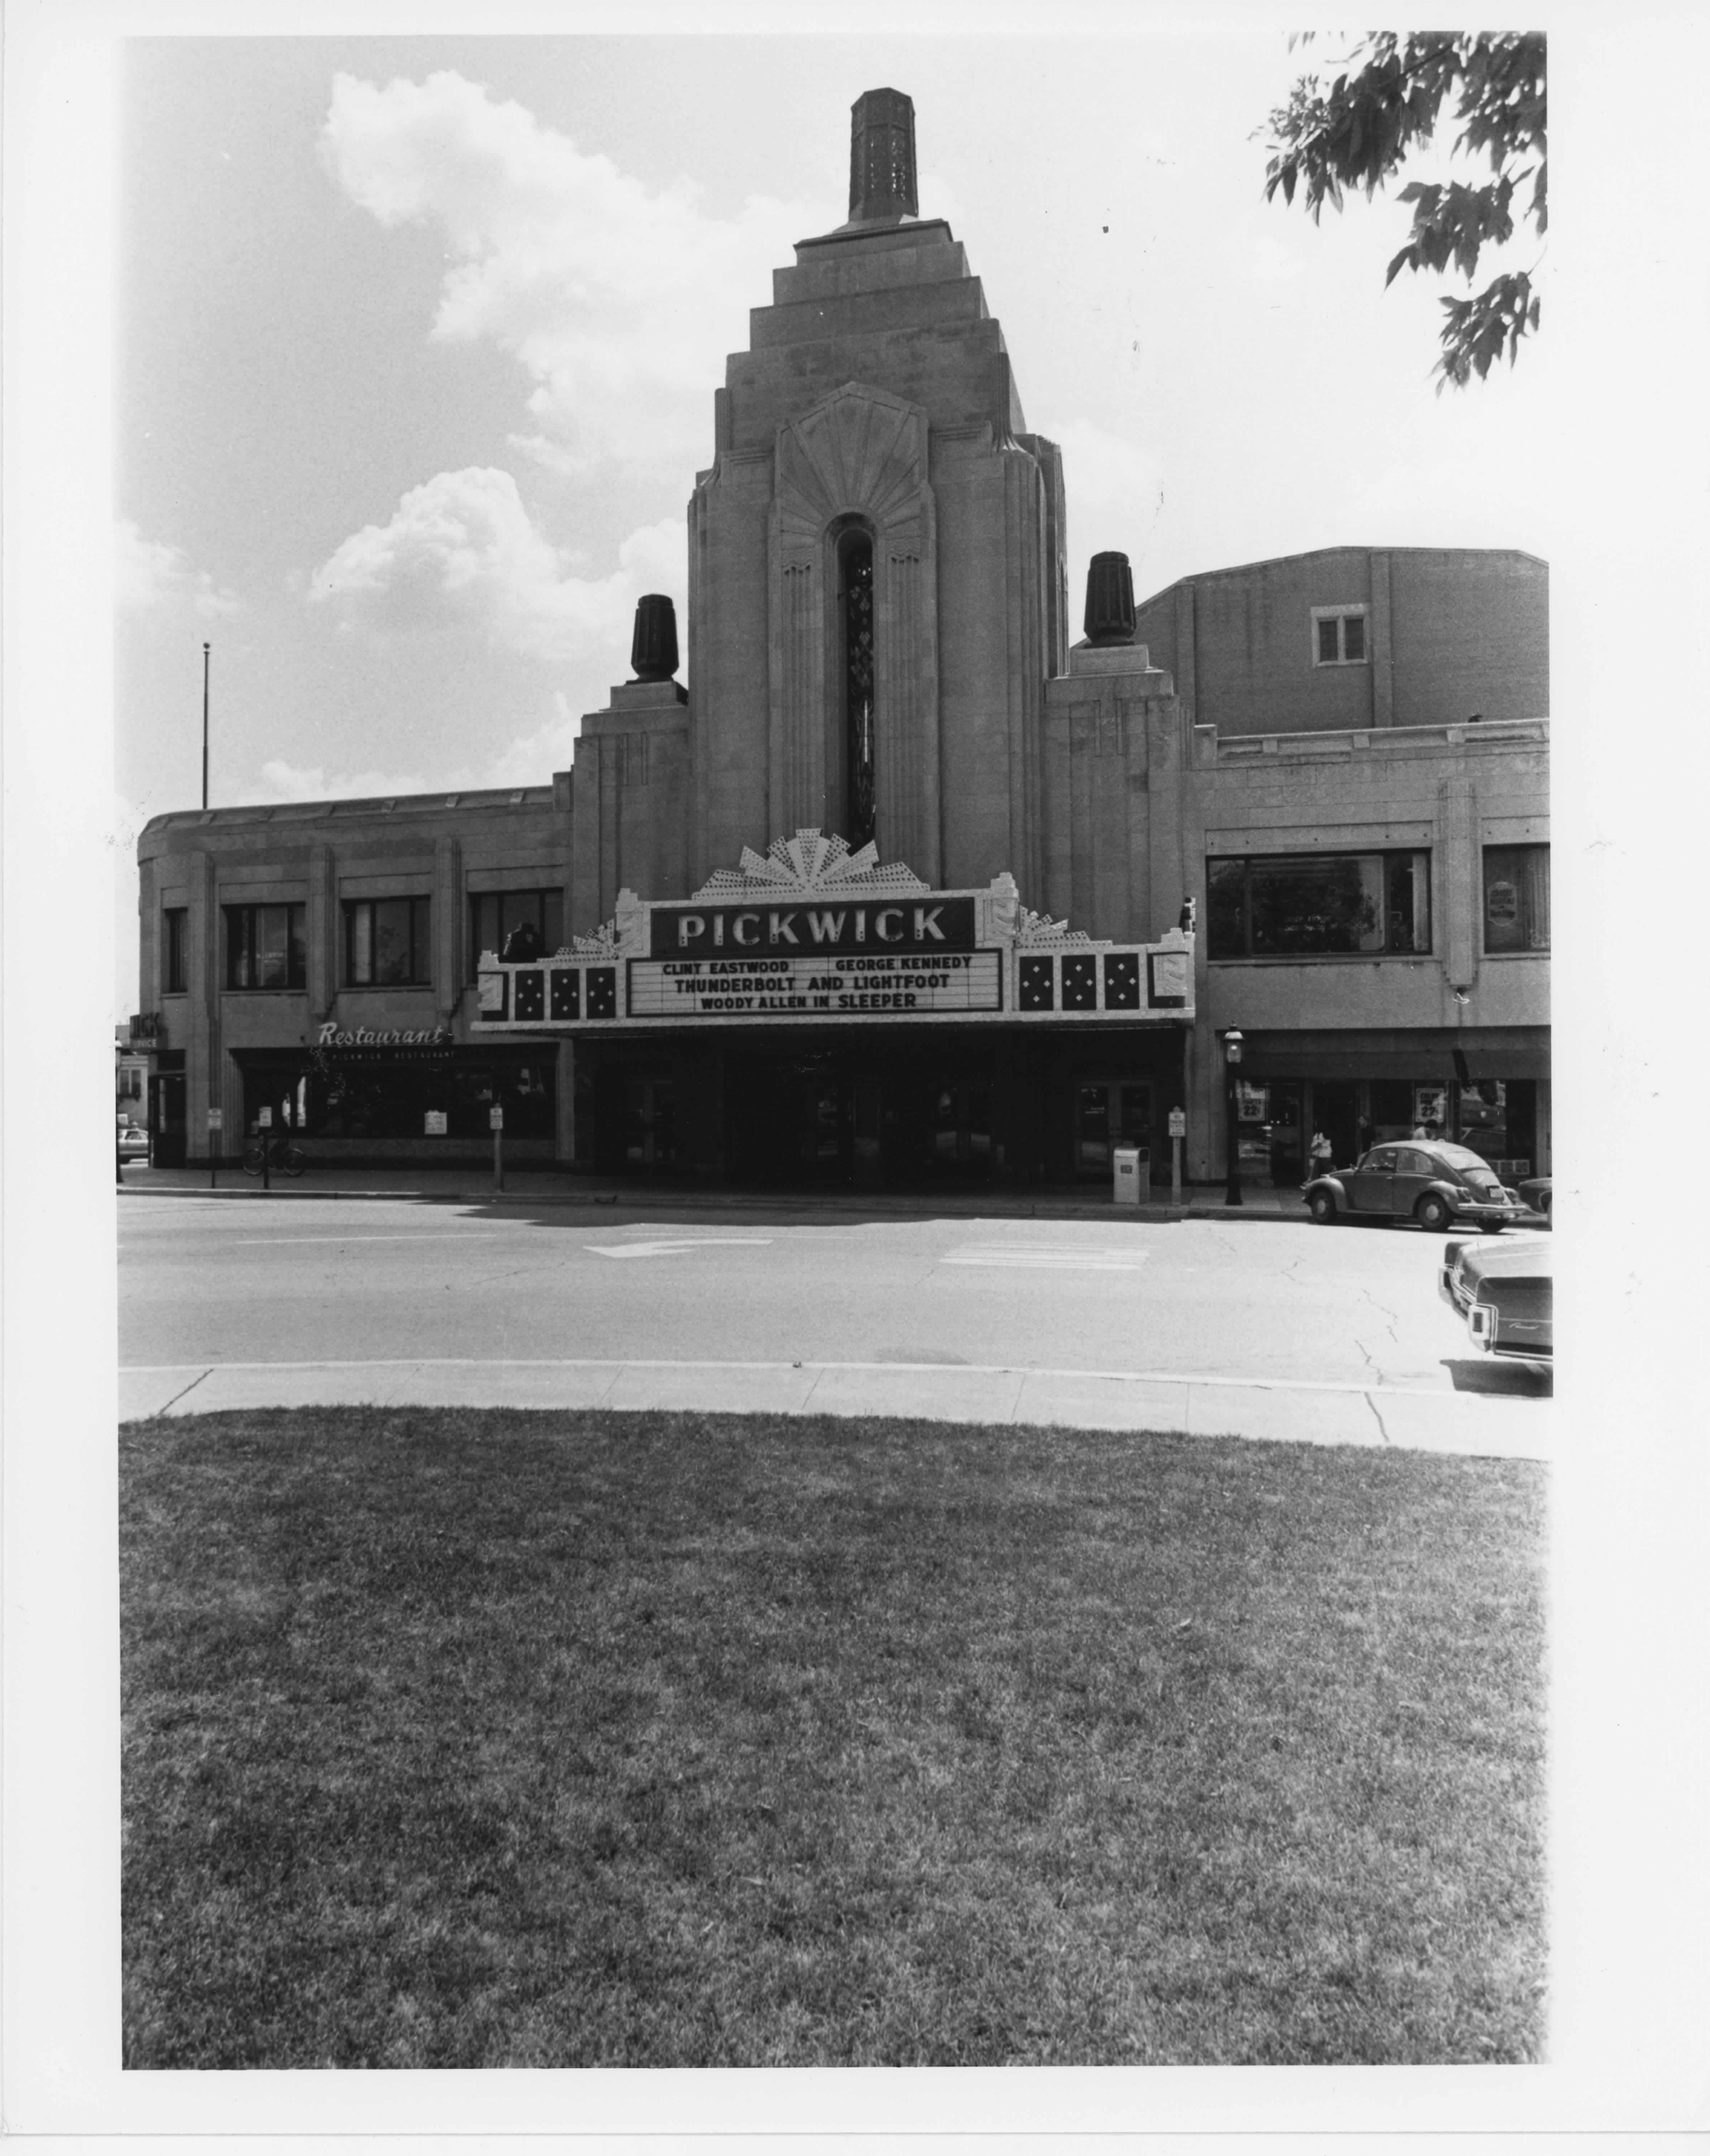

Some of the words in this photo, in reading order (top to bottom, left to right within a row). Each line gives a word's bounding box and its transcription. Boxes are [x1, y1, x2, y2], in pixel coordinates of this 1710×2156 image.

[677, 906, 946, 948] PICKWICK
[663, 962, 701, 976] CLINT
[709, 960, 789, 974] EASTWOOD
[835, 959, 895, 972] GEORGE
[900, 956, 972, 970] KENNEDY
[675, 978, 796, 993] THUNDERBOLT
[808, 976, 844, 990] AND
[853, 974, 950, 989] LIGHTFOOT
[701, 996, 754, 1009] WOODY
[758, 995, 807, 1008] ALLEN
[814, 995, 829, 1007] IN
[838, 993, 917, 1007] SLEEPER
[318, 1021, 444, 1046] Restaurant
[394, 1050, 455, 1060] RESTAURANT
